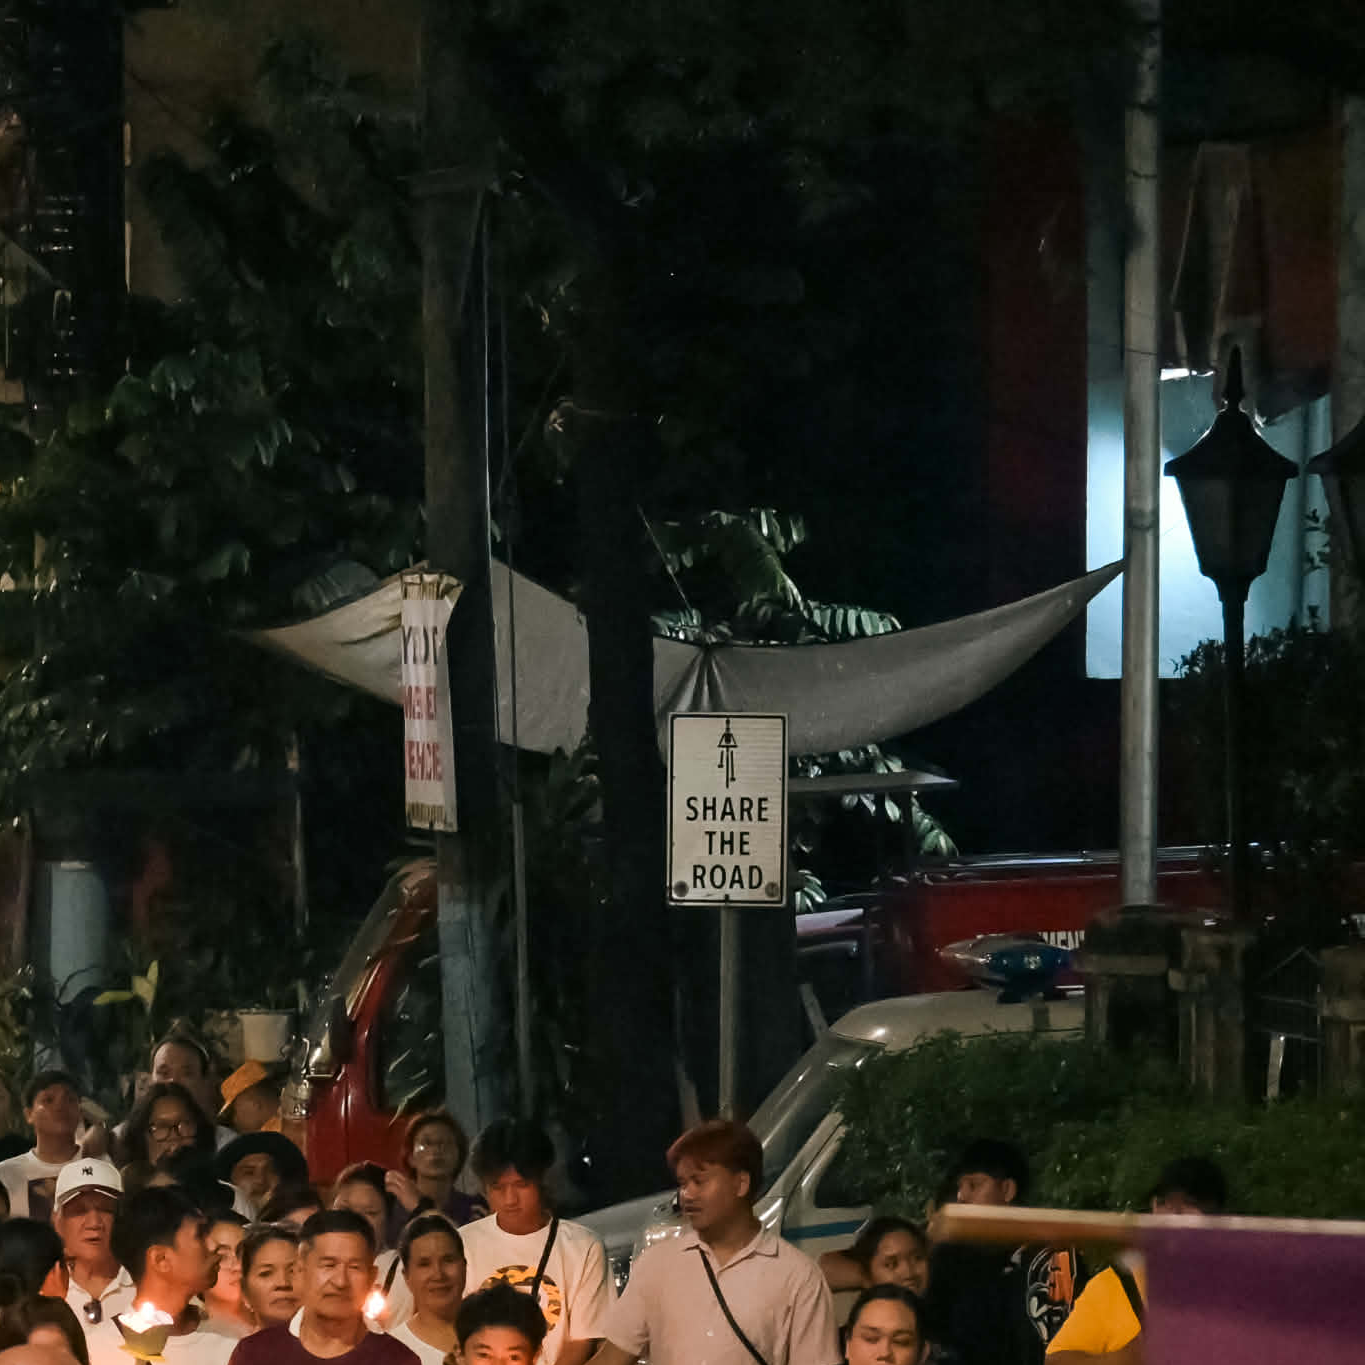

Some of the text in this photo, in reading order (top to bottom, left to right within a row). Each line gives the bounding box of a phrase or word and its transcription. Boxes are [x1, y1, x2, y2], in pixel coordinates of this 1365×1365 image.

[685, 796, 769, 822] SHARE
[704, 831, 750, 856] THE
[692, 864, 763, 890] ROAD
